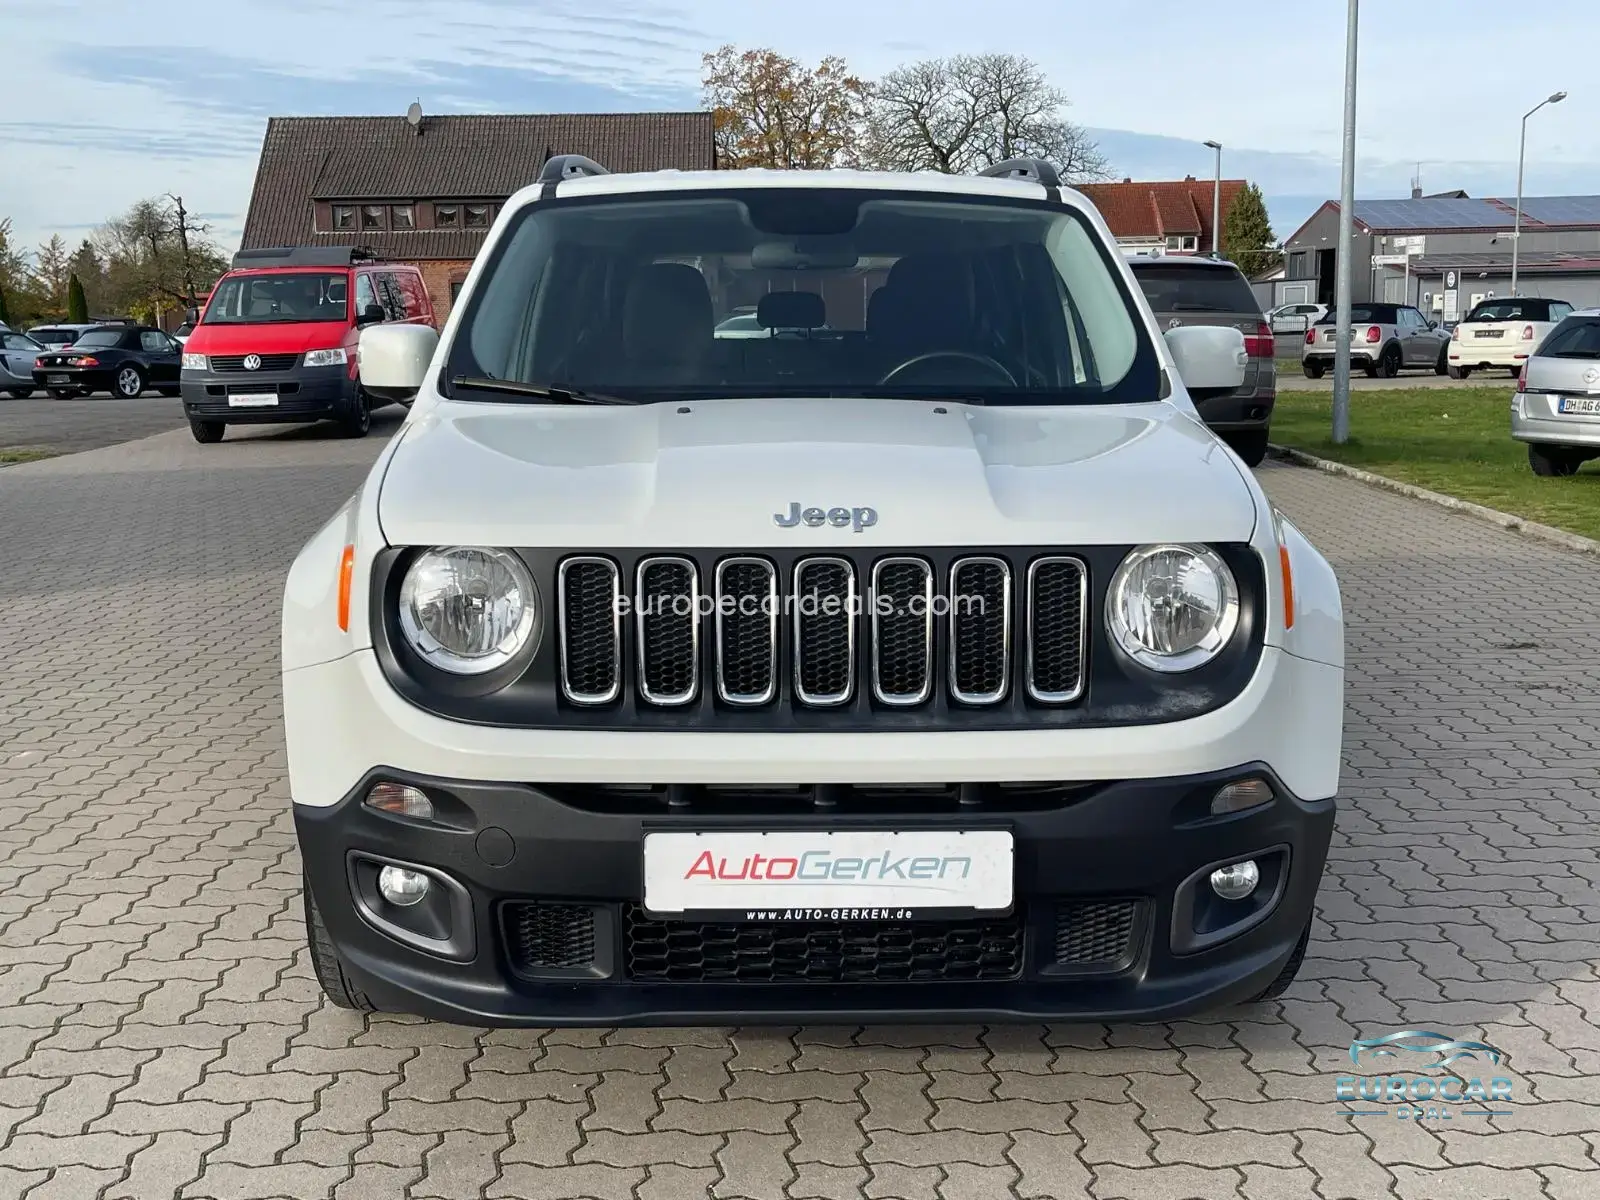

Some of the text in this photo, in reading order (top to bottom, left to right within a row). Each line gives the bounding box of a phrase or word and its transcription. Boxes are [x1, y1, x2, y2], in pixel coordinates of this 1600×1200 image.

[1565, 400, 1577, 410] DH
[1582, 401, 1594, 411] AG
[773, 502, 878, 533] Jeep
[684, 850, 971, 880] AutoGerken
[746, 908, 913, 920] www.AUTO-GERKEN.de
